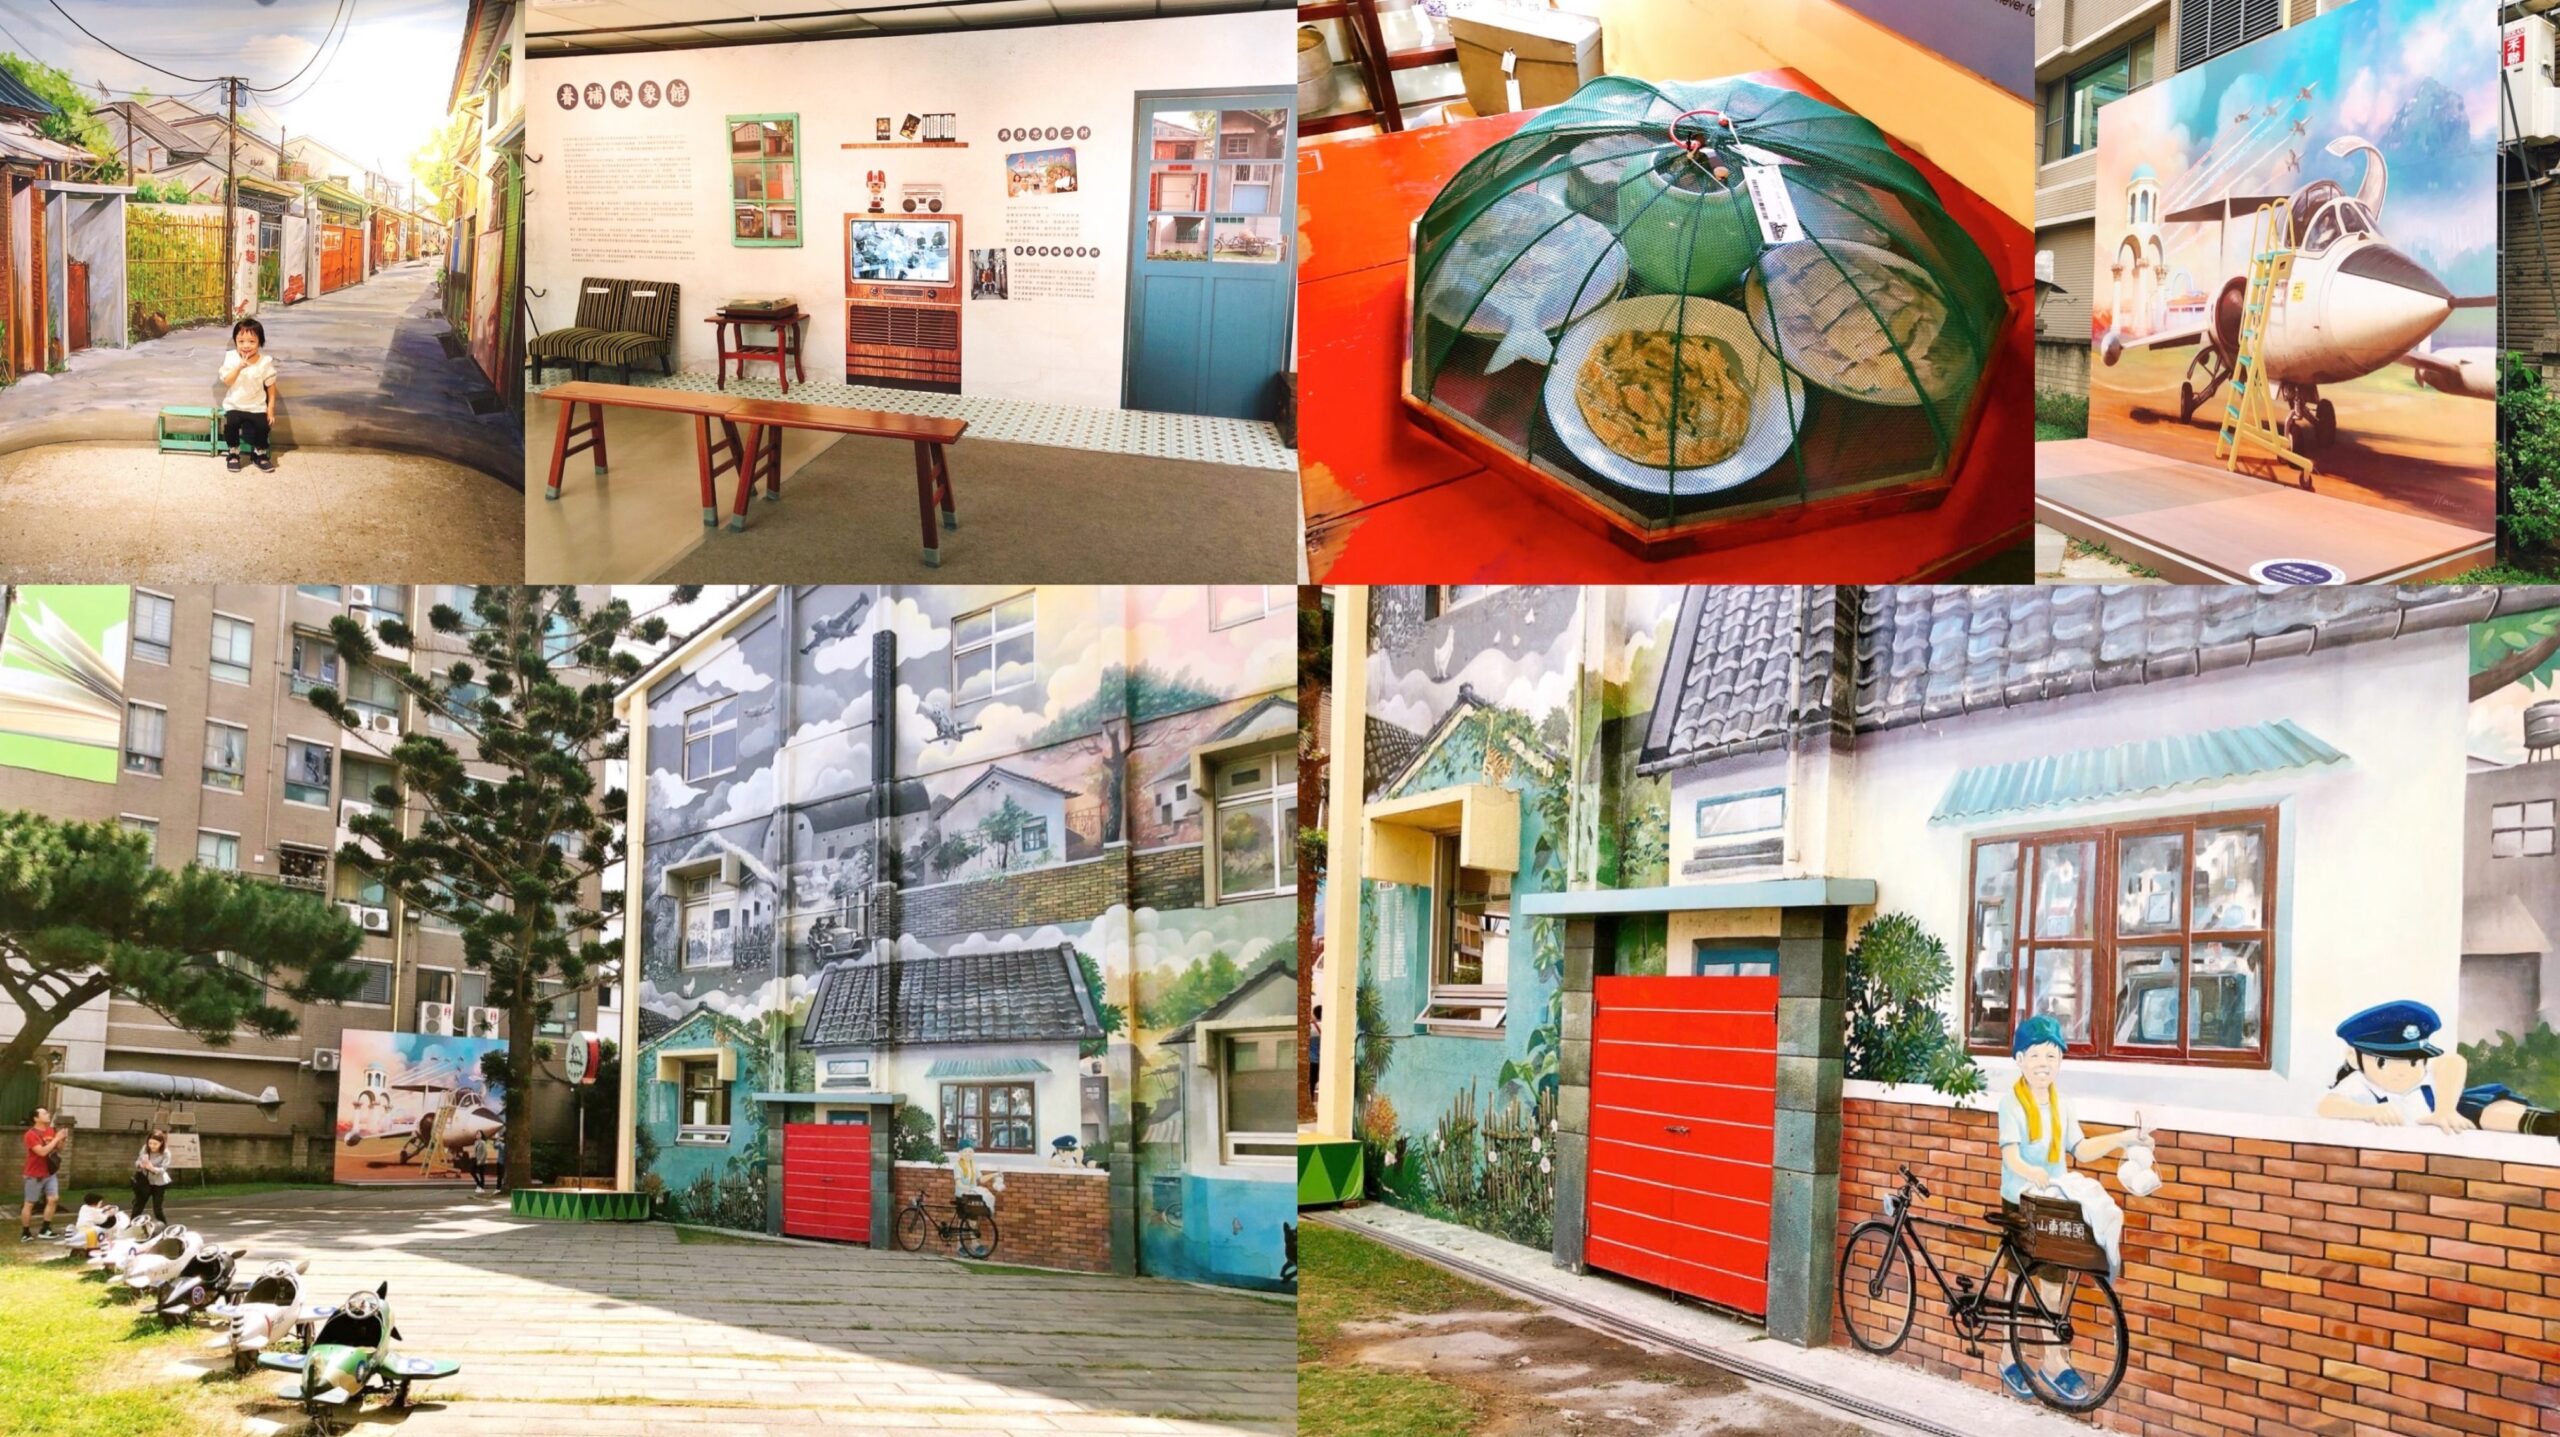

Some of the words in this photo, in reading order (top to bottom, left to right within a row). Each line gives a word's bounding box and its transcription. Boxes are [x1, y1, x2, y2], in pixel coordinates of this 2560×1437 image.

[1995, 0, 2024, 12] ever
[2036, 1218, 2085, 1240] 山東饅頭
